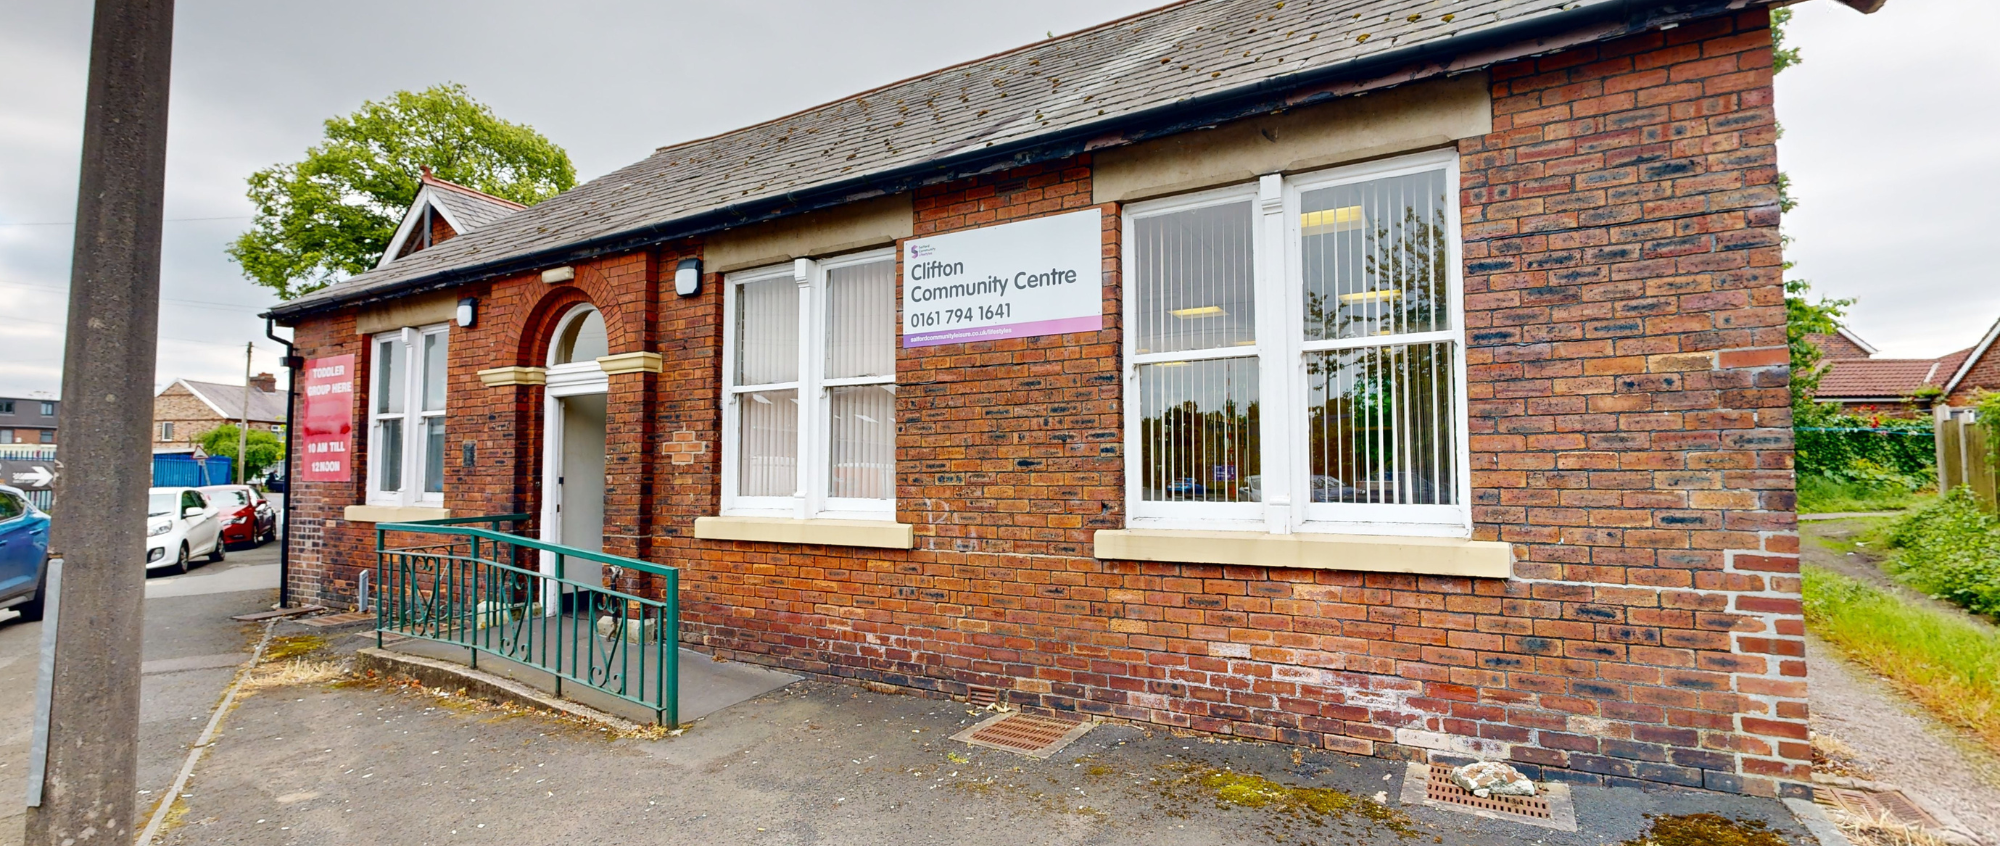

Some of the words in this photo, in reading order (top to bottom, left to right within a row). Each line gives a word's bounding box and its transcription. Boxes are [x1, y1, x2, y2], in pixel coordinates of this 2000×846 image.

[911, 260, 964, 281] Clifton
[911, 275, 1009, 303] Community
[1014, 267, 1077, 290] Centre
[911, 311, 940, 328] 0161
[945, 307, 973, 325] 794
[978, 302, 1011, 321] 1641
[312, 365, 345, 378] TODDLER
[307, 385, 331, 396] GROUP
[332, 382, 352, 393] HERE
[308, 443, 316, 454] 10
[317, 442, 328, 453] AM
[329, 441, 346, 453] TILL
